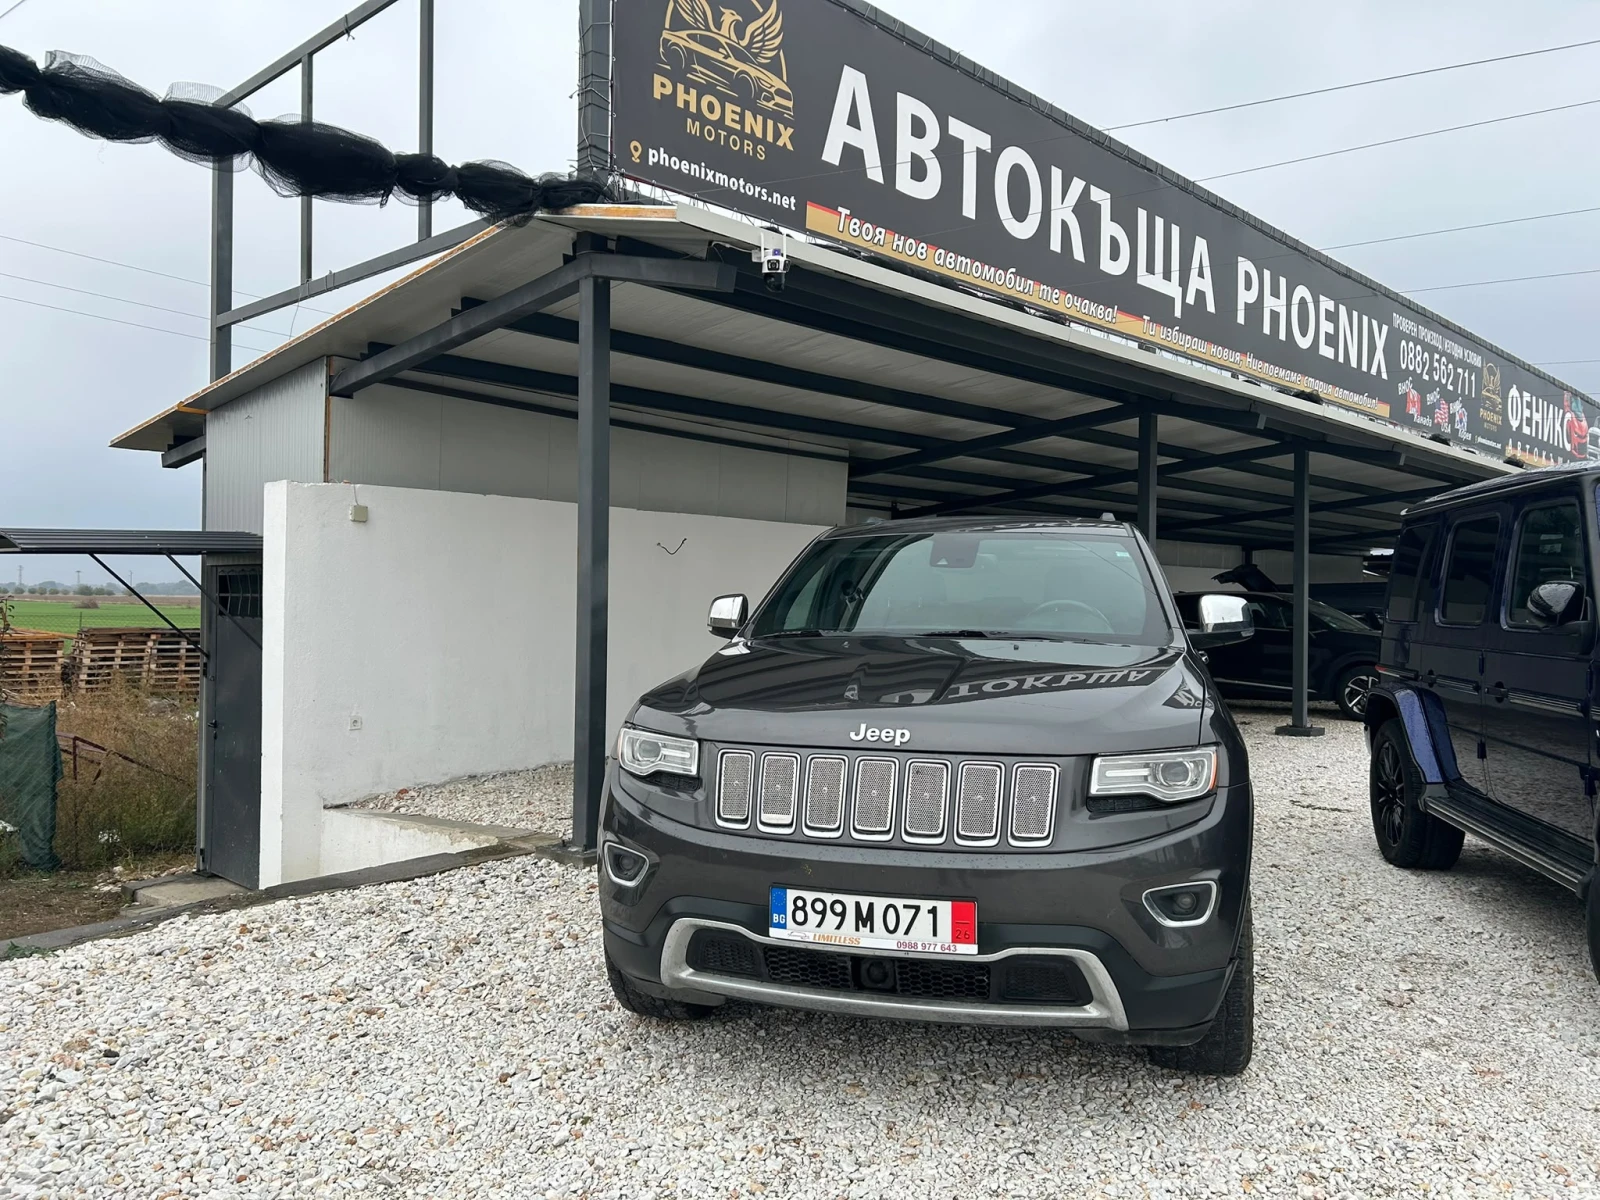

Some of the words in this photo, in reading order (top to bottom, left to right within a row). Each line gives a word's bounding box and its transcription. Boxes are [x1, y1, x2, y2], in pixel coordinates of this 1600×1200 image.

[653, 73, 795, 151] PHOENIX
[686, 118, 766, 160] MOTORS
[648, 147, 796, 210] phoenixmotors.net
[821, 64, 1216, 318] АВТОКЪЩА
[837, 206, 887, 246] Твоя
[892, 231, 928, 260] нов
[934, 248, 1034, 296] автомобил
[1038, 282, 1060, 304] те
[1064, 292, 1118, 324] очаква!
[1237, 256, 1389, 380] PHOENIX
[1392, 312, 1417, 337] ПРОВЕРЕН
[1142, 315, 1156, 336] Ти
[1159, 323, 1209, 354] избираш
[1303, 375, 1332, 397] стария
[1334, 383, 1379, 410] автомобил!
[1400, 339, 1429, 381] 0882
[1433, 353, 1454, 391] 562
[1457, 367, 1476, 398] 711
[1479, 408, 1502, 425] PHOENIX
[1507, 384, 1571, 452] ФЕНИКС
[849, 722, 911, 748] Jeep
[773, 913, 786, 924] BG
[812, 933, 861, 946] LIMITLESS
[955, 929, 970, 940] 26
[896, 940, 919, 951] 0988
[921, 942, 938, 952] 977
[940, 943, 958, 953] 643
